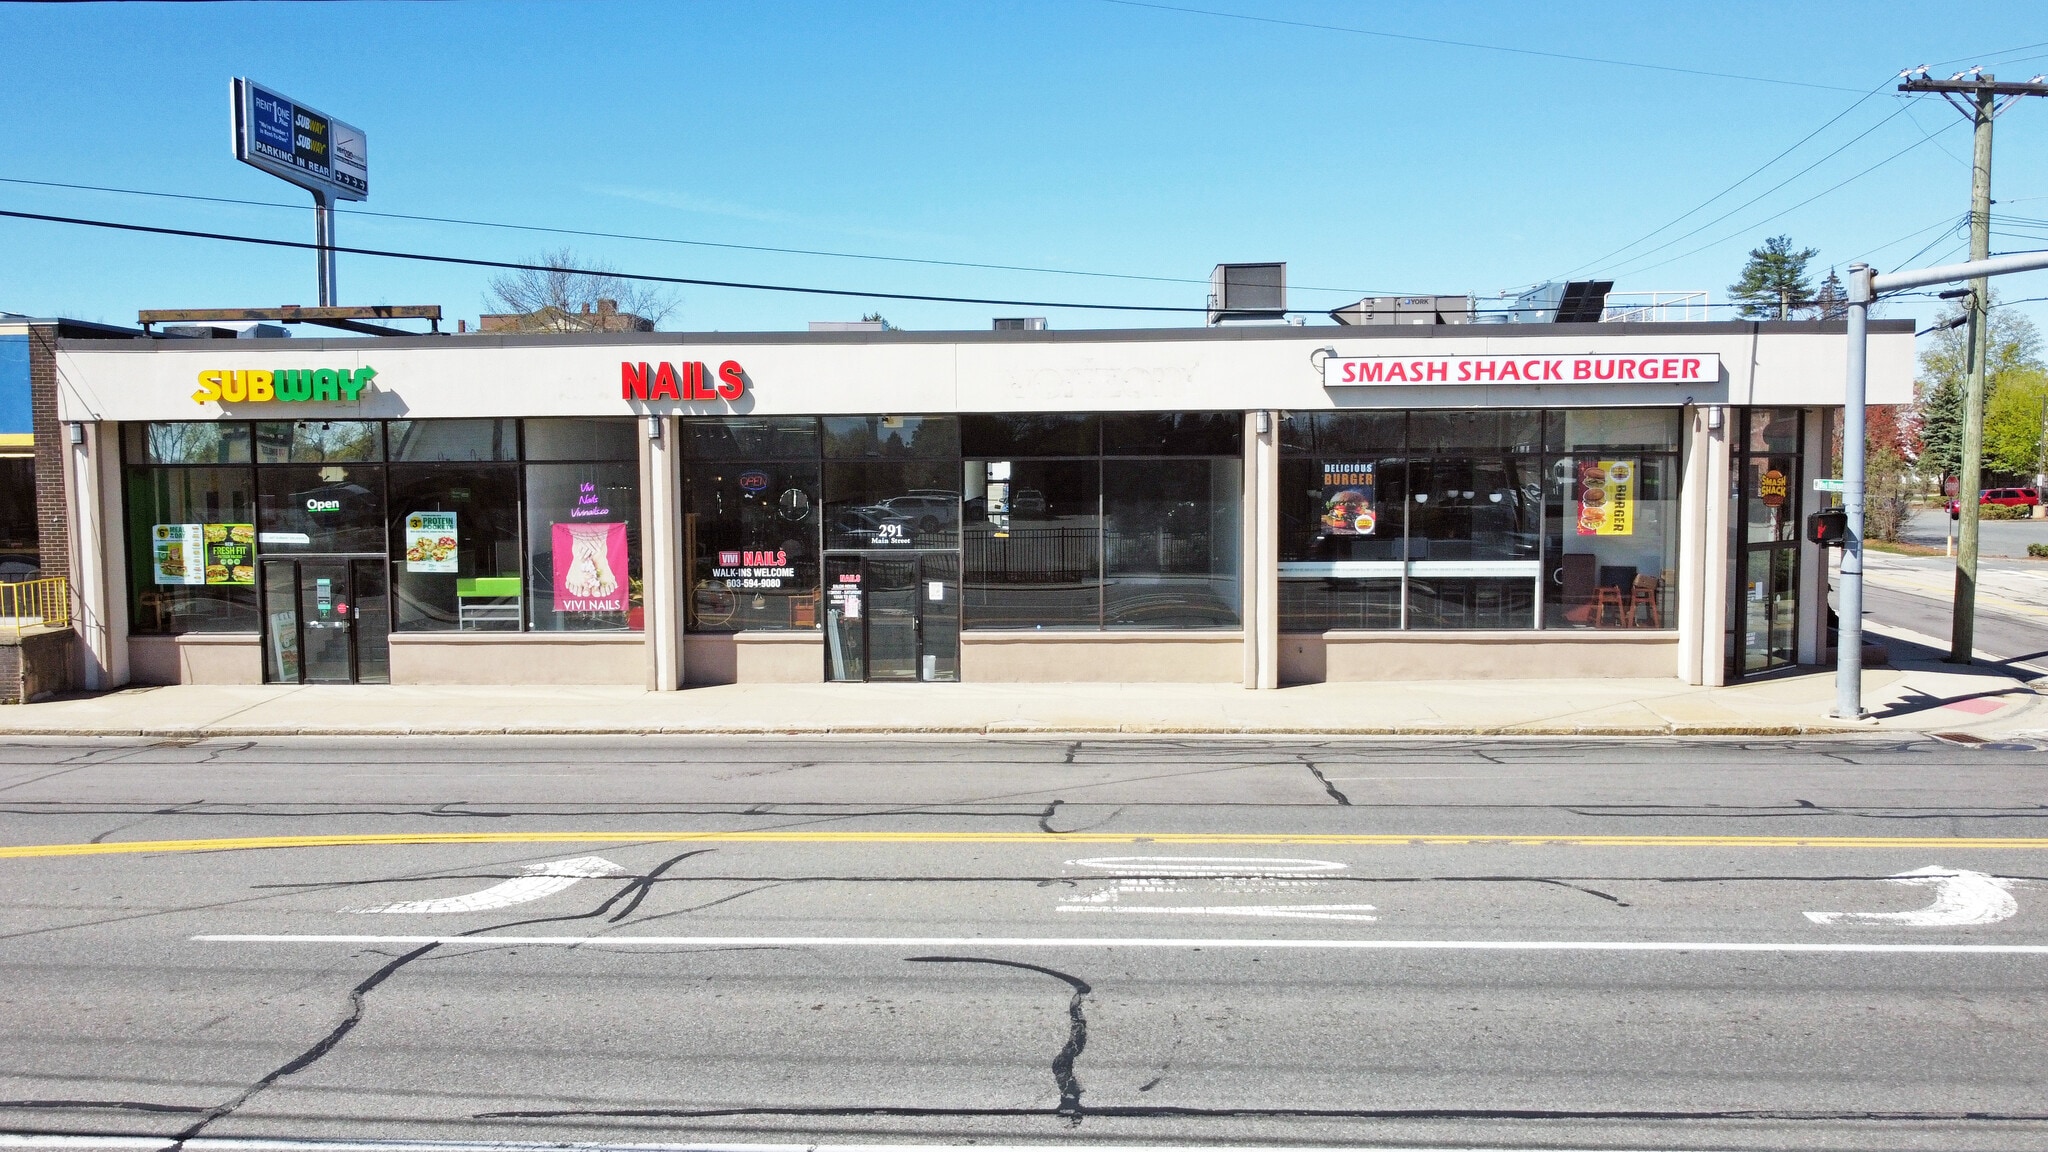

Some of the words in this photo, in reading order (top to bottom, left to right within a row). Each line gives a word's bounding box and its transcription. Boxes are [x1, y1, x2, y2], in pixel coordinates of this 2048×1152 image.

[255, 97, 272, 112] RENT
[277, 106, 290, 120] ONE
[295, 113, 326, 135] SUBWAY
[296, 133, 327, 155] SUBWAY
[256, 141, 294, 163] PARKING
[296, 156, 306, 167] IN
[308, 161, 330, 176] REAR
[1341, 360, 1449, 383] SMASH
[1457, 359, 1564, 382] SHACK
[1572, 358, 1702, 380] BURGER
[191, 365, 378, 405] SUBWAY
[621, 359, 745, 401] NAILS
[1324, 464, 1373, 473] DELICIOUS
[1324, 473, 1373, 486] BURGER
[1761, 474, 1787, 487] SMASH
[1761, 485, 1787, 498] SHACK
[1945, 482, 1960, 491] STOP
[306, 498, 340, 512] Open
[578, 494, 599, 505] Nails
[1613, 485, 1627, 532] BURGER
[422, 517, 454, 525] PROTEIN
[878, 524, 904, 538] 291
[212, 546, 235, 555] FRESH
[236, 546, 247, 555] FIT
[722, 554, 738, 563] VIVI
[743, 550, 787, 567] NAILS
[712, 568, 752, 577] WALK-INS
[753, 567, 795, 577] WELCOME
[839, 574, 861, 583] NAILS
[726, 578, 781, 588] 603-594-9080
[563, 600, 586, 610] VIVI
[589, 600, 621, 610] NAILS
